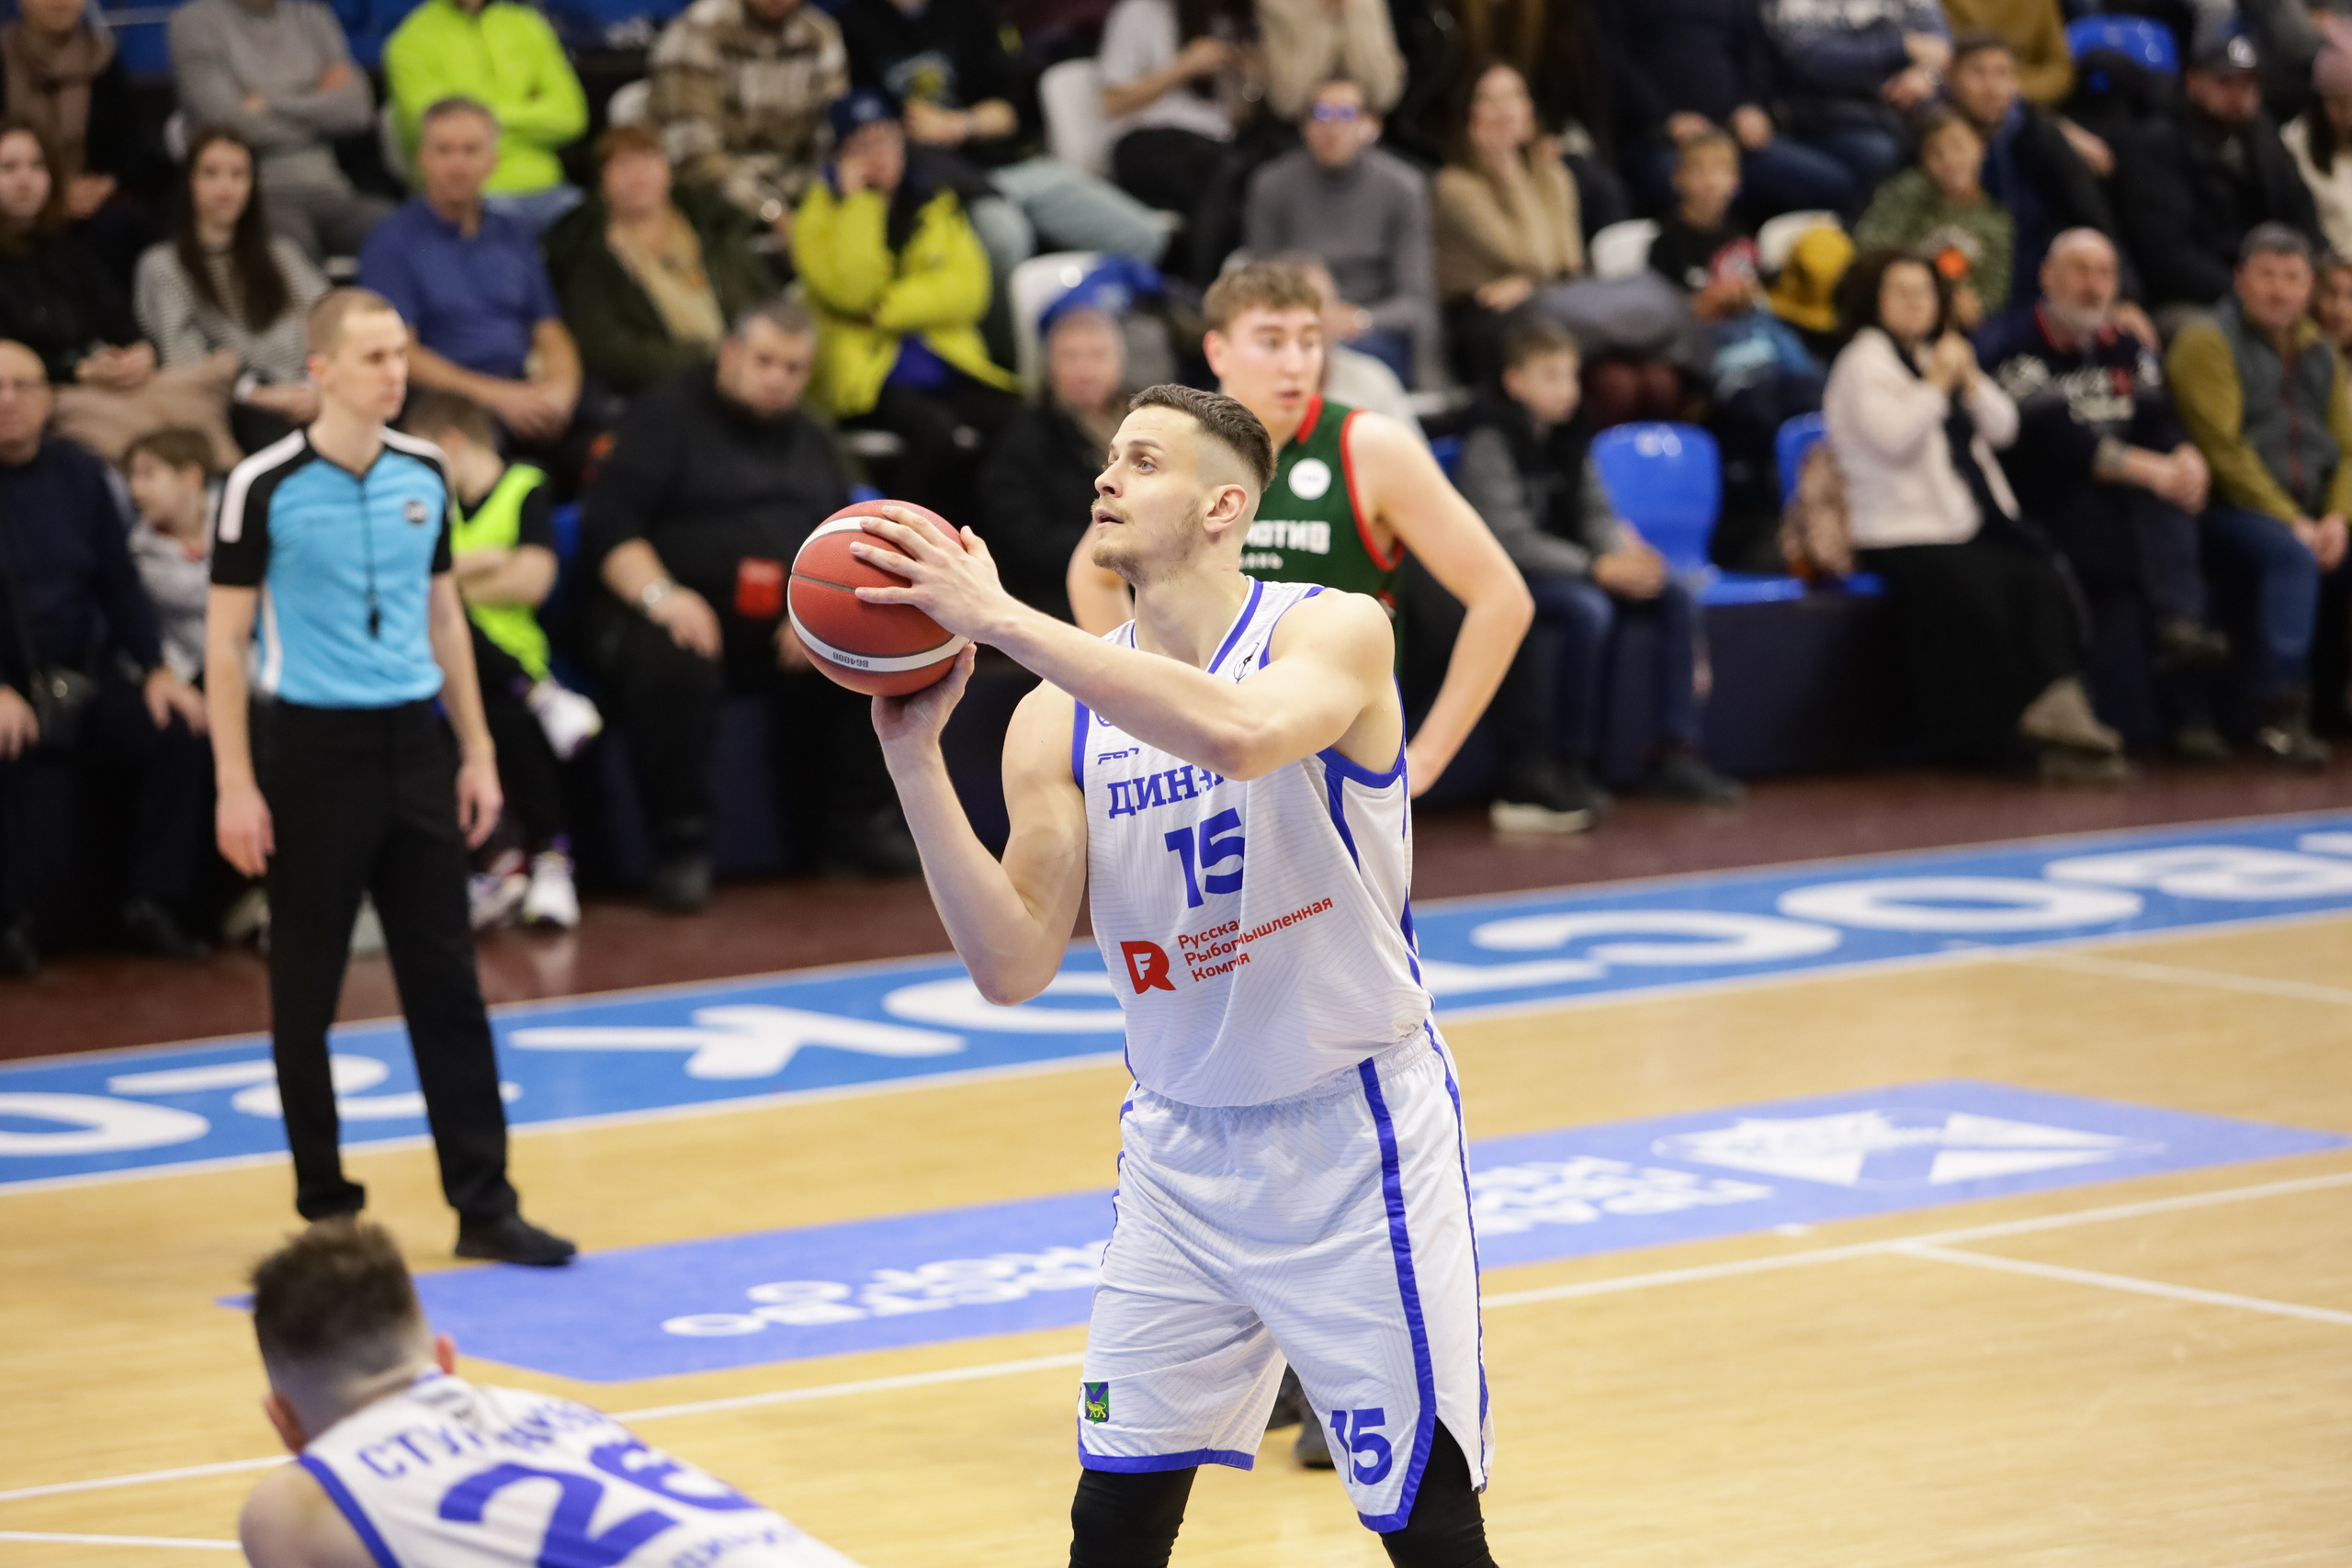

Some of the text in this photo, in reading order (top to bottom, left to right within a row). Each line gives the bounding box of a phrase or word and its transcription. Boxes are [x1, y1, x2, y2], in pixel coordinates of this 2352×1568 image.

[1164, 807, 1245, 908] 15
[1177, 919, 1240, 950] Русска
[1329, 1407, 1392, 1485] 15
